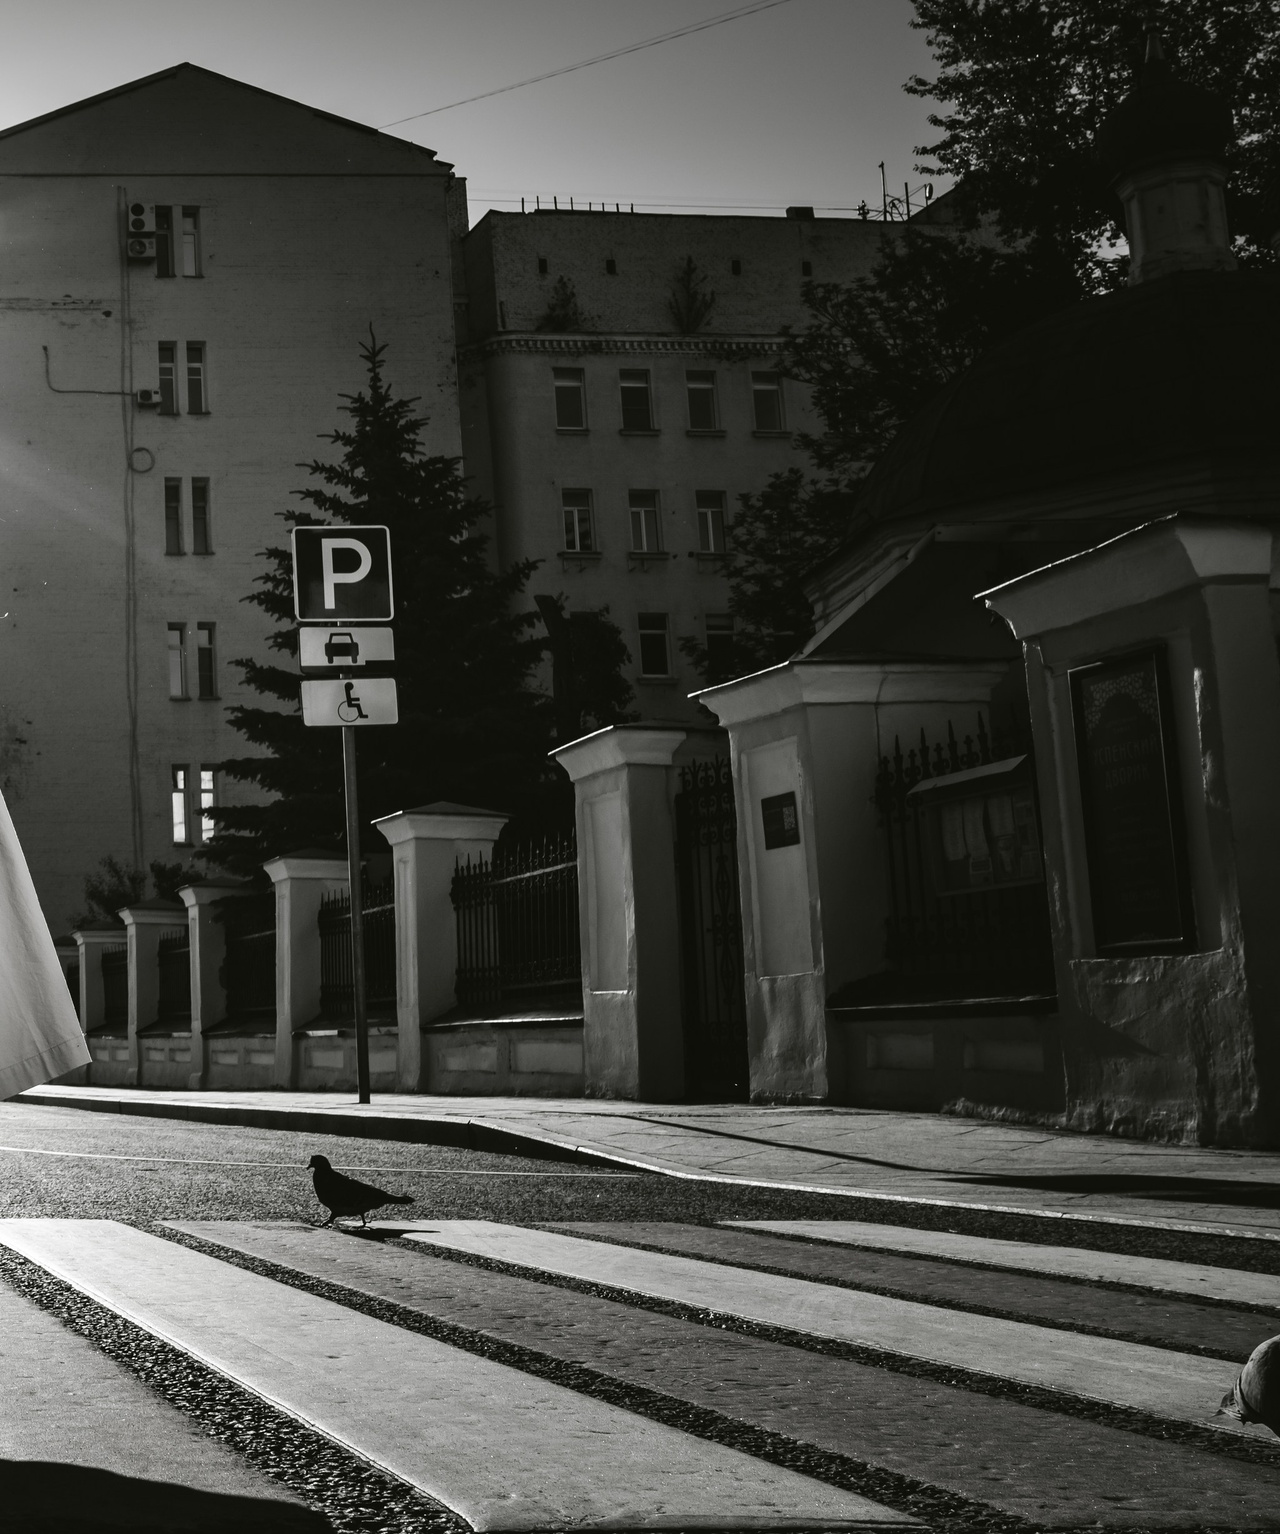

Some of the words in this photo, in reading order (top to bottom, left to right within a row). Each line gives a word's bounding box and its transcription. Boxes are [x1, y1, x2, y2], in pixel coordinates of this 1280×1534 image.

[321, 538, 372, 609] P
[1093, 734, 1159, 766] УСПЕНСКИЙ
[1105, 764, 1150, 790] ДВОРИК
